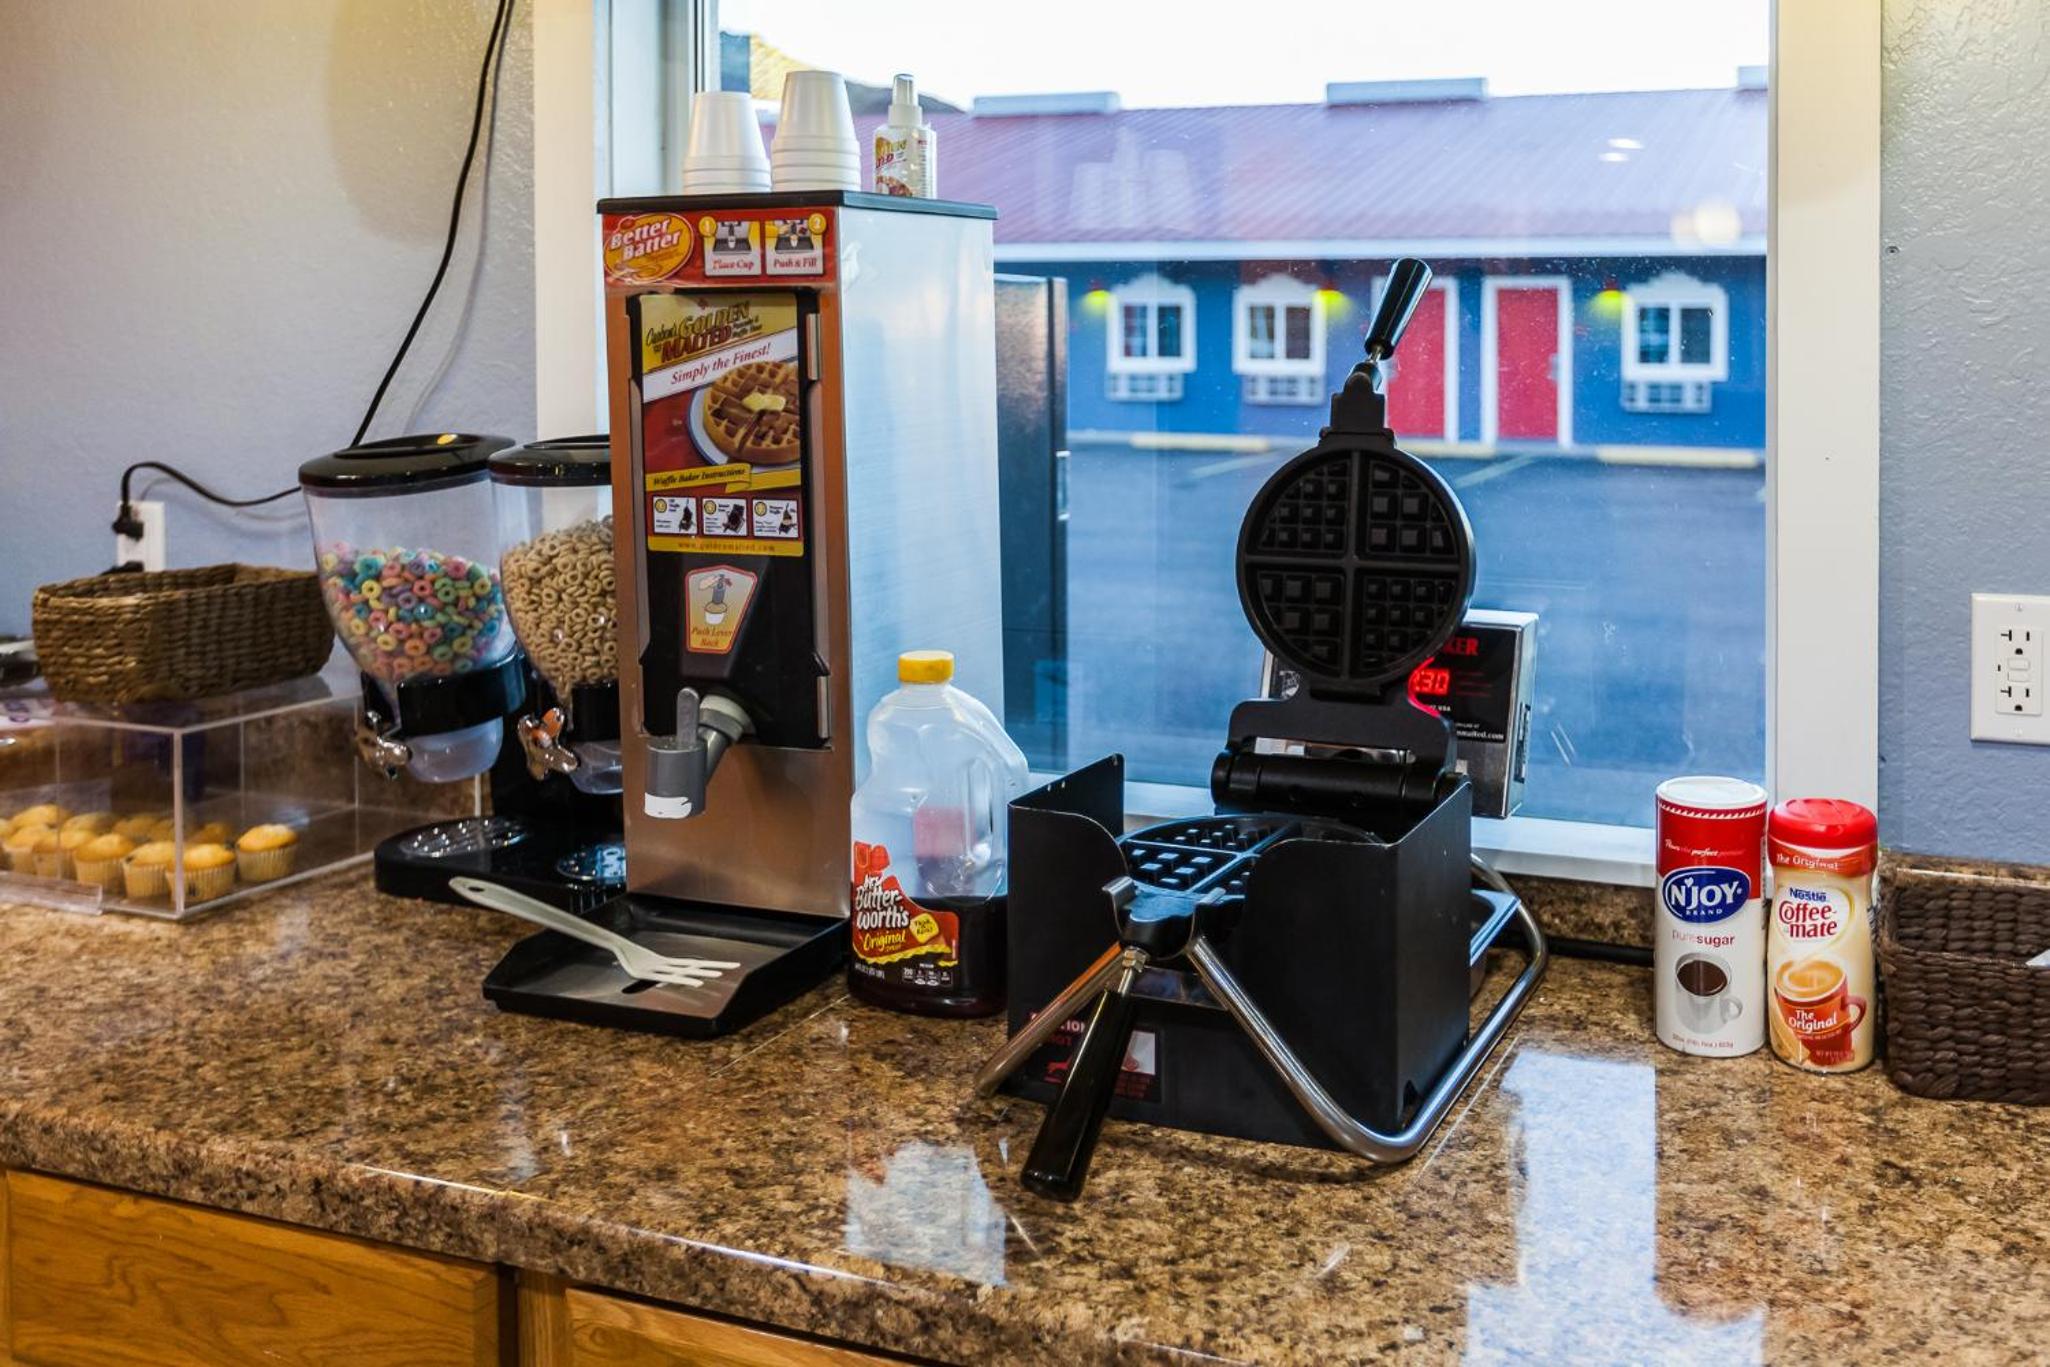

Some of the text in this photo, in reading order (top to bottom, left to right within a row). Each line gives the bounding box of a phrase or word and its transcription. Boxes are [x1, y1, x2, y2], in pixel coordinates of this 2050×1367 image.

[609, 219, 671, 250] Better
[623, 230, 682, 261] Batter
[736, 259, 754, 271] Cup
[774, 259, 794, 268] Push
[802, 258, 818, 268] Fill
[661, 325, 732, 363] MALTED
[671, 342, 772, 385] Simply the Finest!
[1443, 635, 1479, 656] KER
[1792, 855, 1839, 870] Original
[1685, 908, 1724, 916] BRAND
[1789, 920, 1839, 938] mate
[863, 930, 906, 952] Original
[1788, 1011, 1837, 1034] Original
[1795, 1009, 1815, 1020] The
